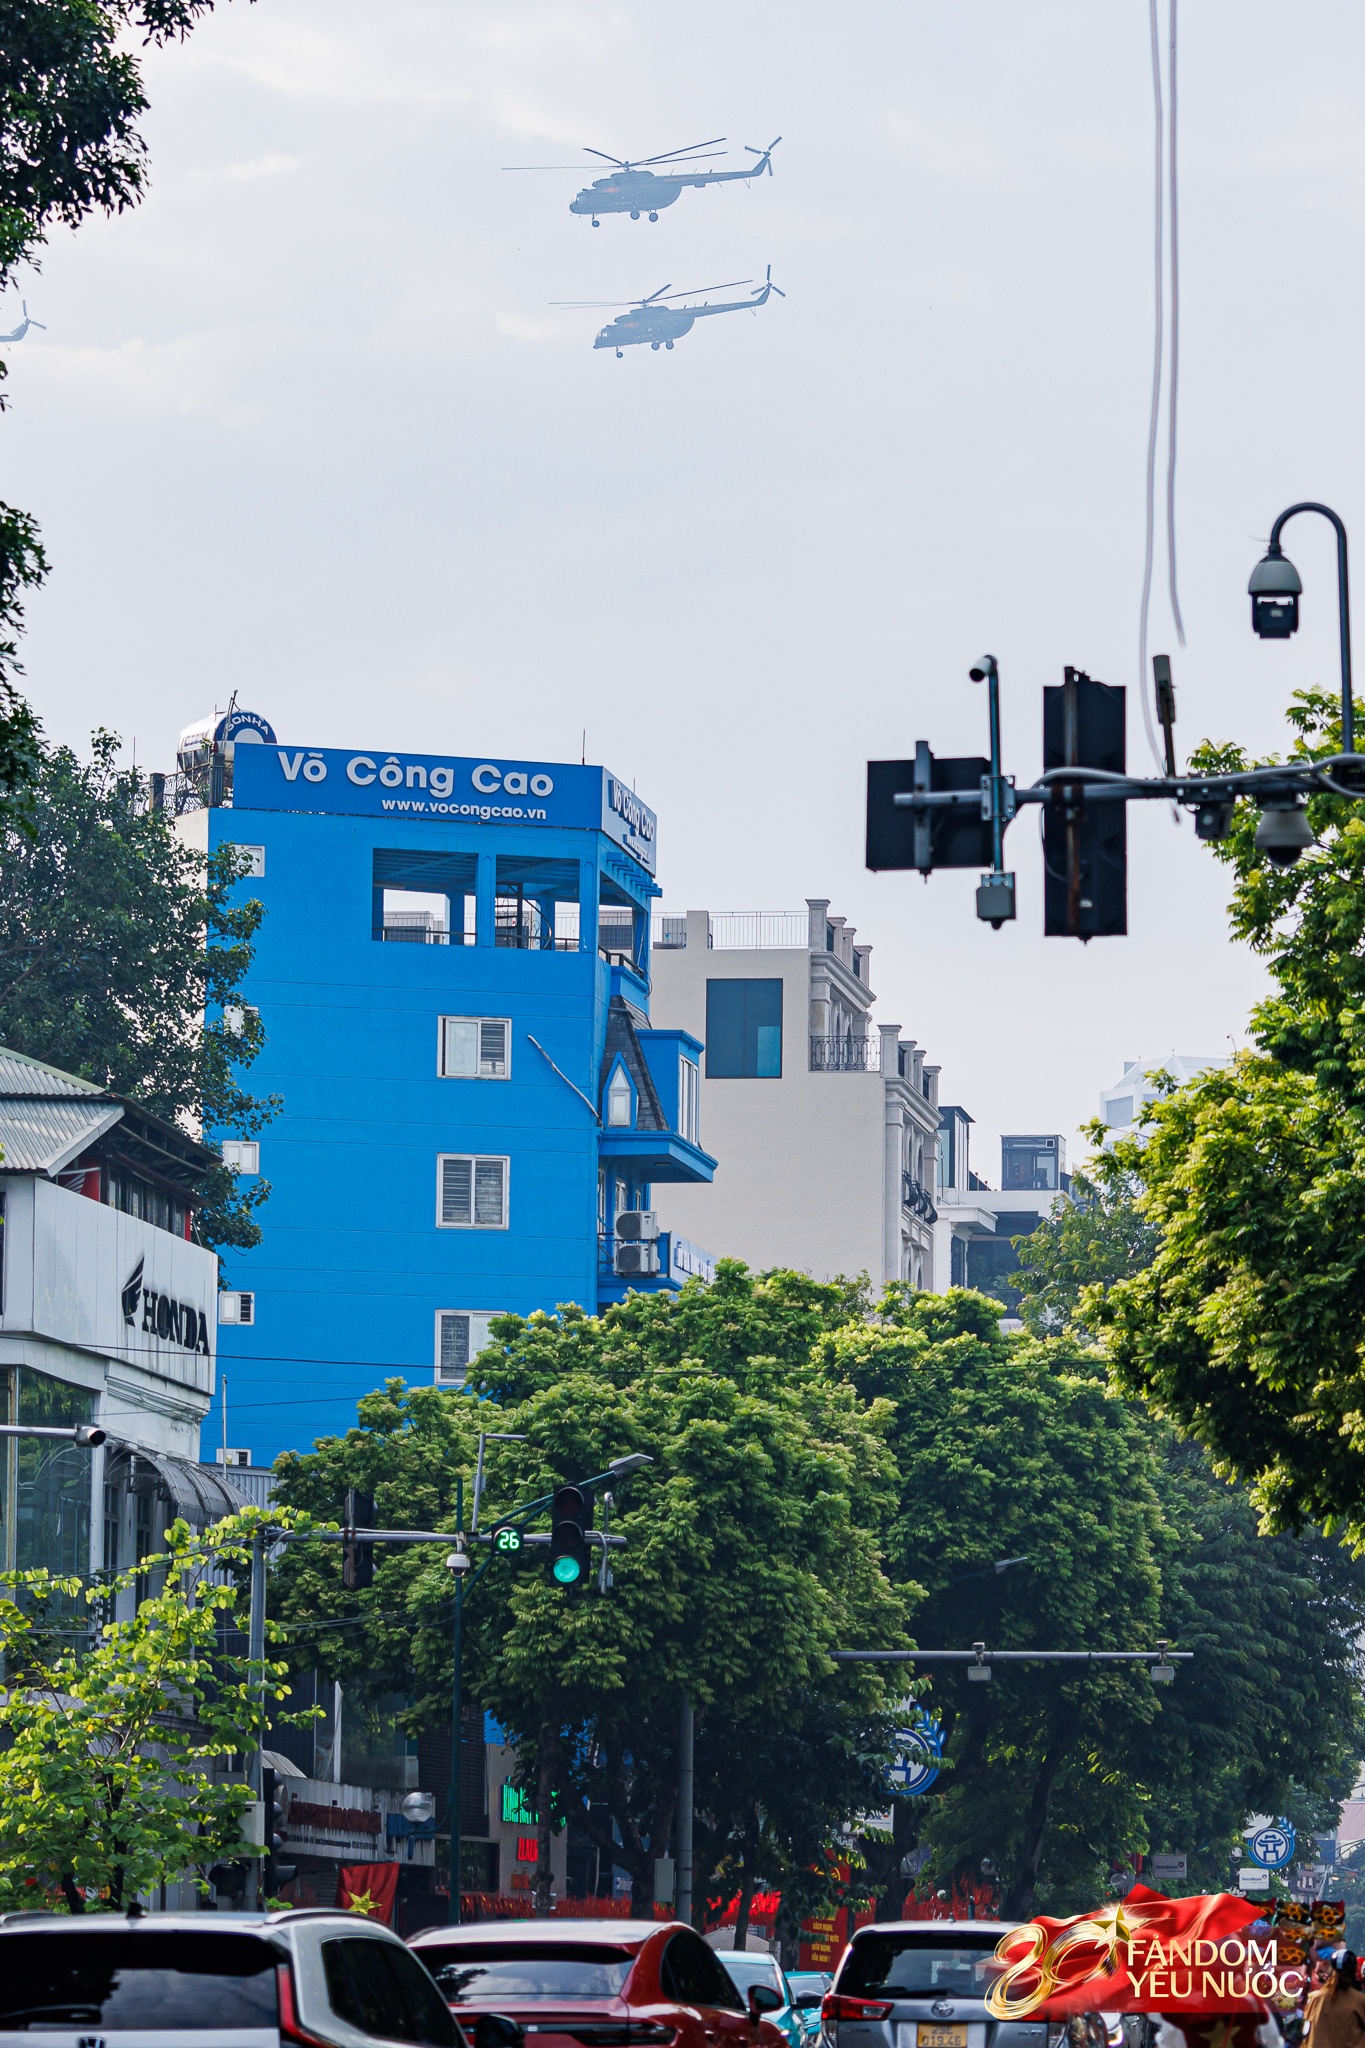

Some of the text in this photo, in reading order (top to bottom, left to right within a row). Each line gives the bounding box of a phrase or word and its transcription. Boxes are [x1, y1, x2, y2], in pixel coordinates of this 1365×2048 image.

[277, 751, 554, 798] Võ Công Cao
[381, 799, 547, 820] www.vocongcao.vn
[142, 1287, 210, 1355] HONDA
[499, 1531, 520, 1549] 26
